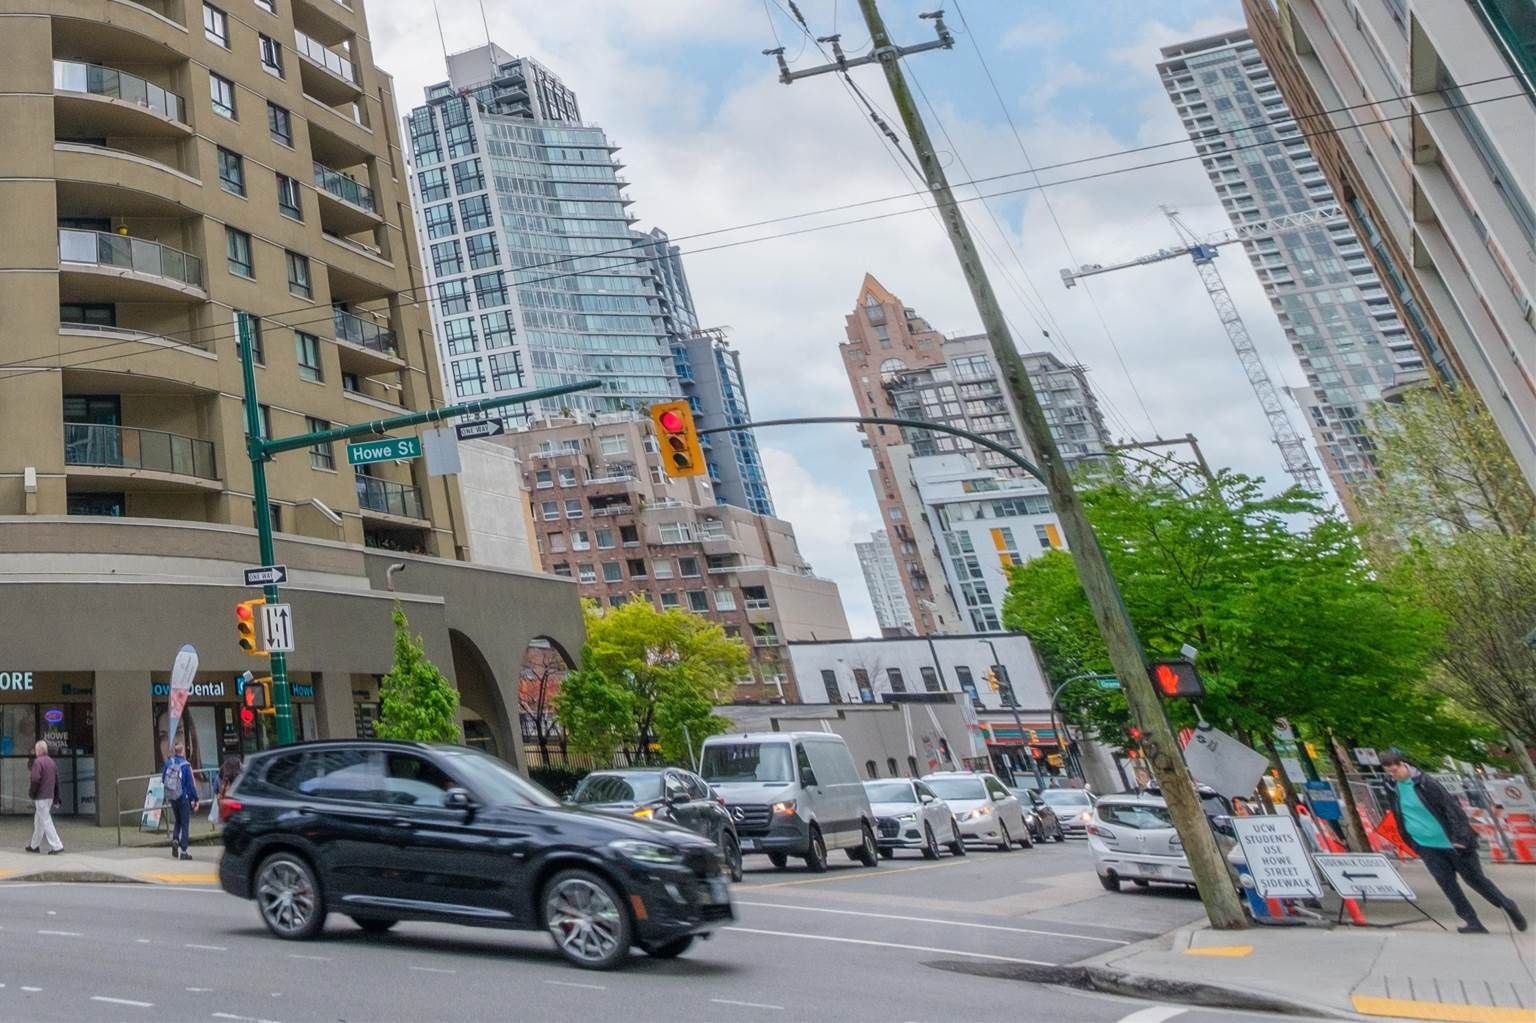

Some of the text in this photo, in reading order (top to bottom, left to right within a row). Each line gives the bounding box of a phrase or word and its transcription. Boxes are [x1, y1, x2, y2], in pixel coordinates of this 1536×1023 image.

[353, 441, 415, 461] Howe St
[1253, 825, 1276, 833] UCW
[1245, 834, 1294, 844] STUDENTS
[1264, 846, 1282, 855] USE
[1262, 856, 1292, 865] HOWE
[1265, 867, 1299, 877] STREET
[1260, 878, 1313, 889] SIDEWALK
